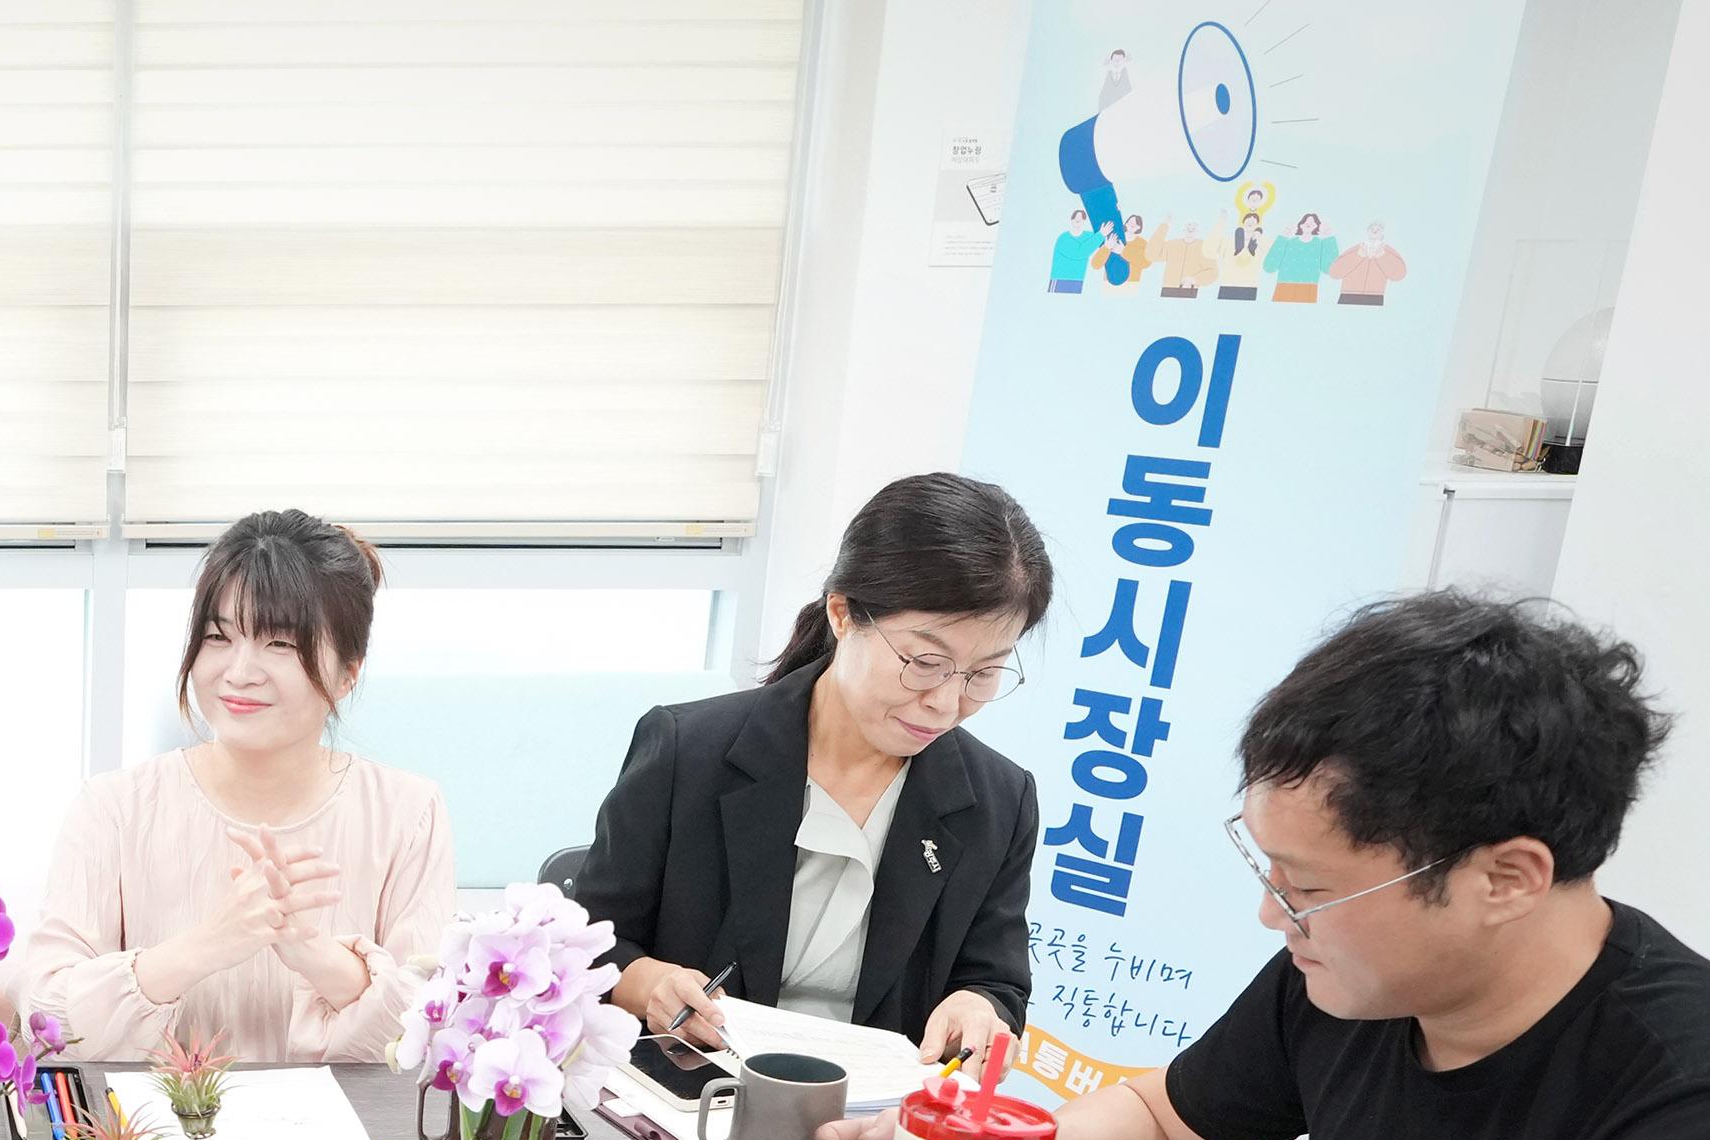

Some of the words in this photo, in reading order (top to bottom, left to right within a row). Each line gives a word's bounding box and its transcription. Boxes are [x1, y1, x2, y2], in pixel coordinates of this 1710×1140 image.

[1043, 333, 1242, 917] 이동시장실
[1104, 942, 1193, 989] 누비며
[1052, 985, 1193, 1047] 직통합니다
[1018, 1031, 1128, 1095] 통버
